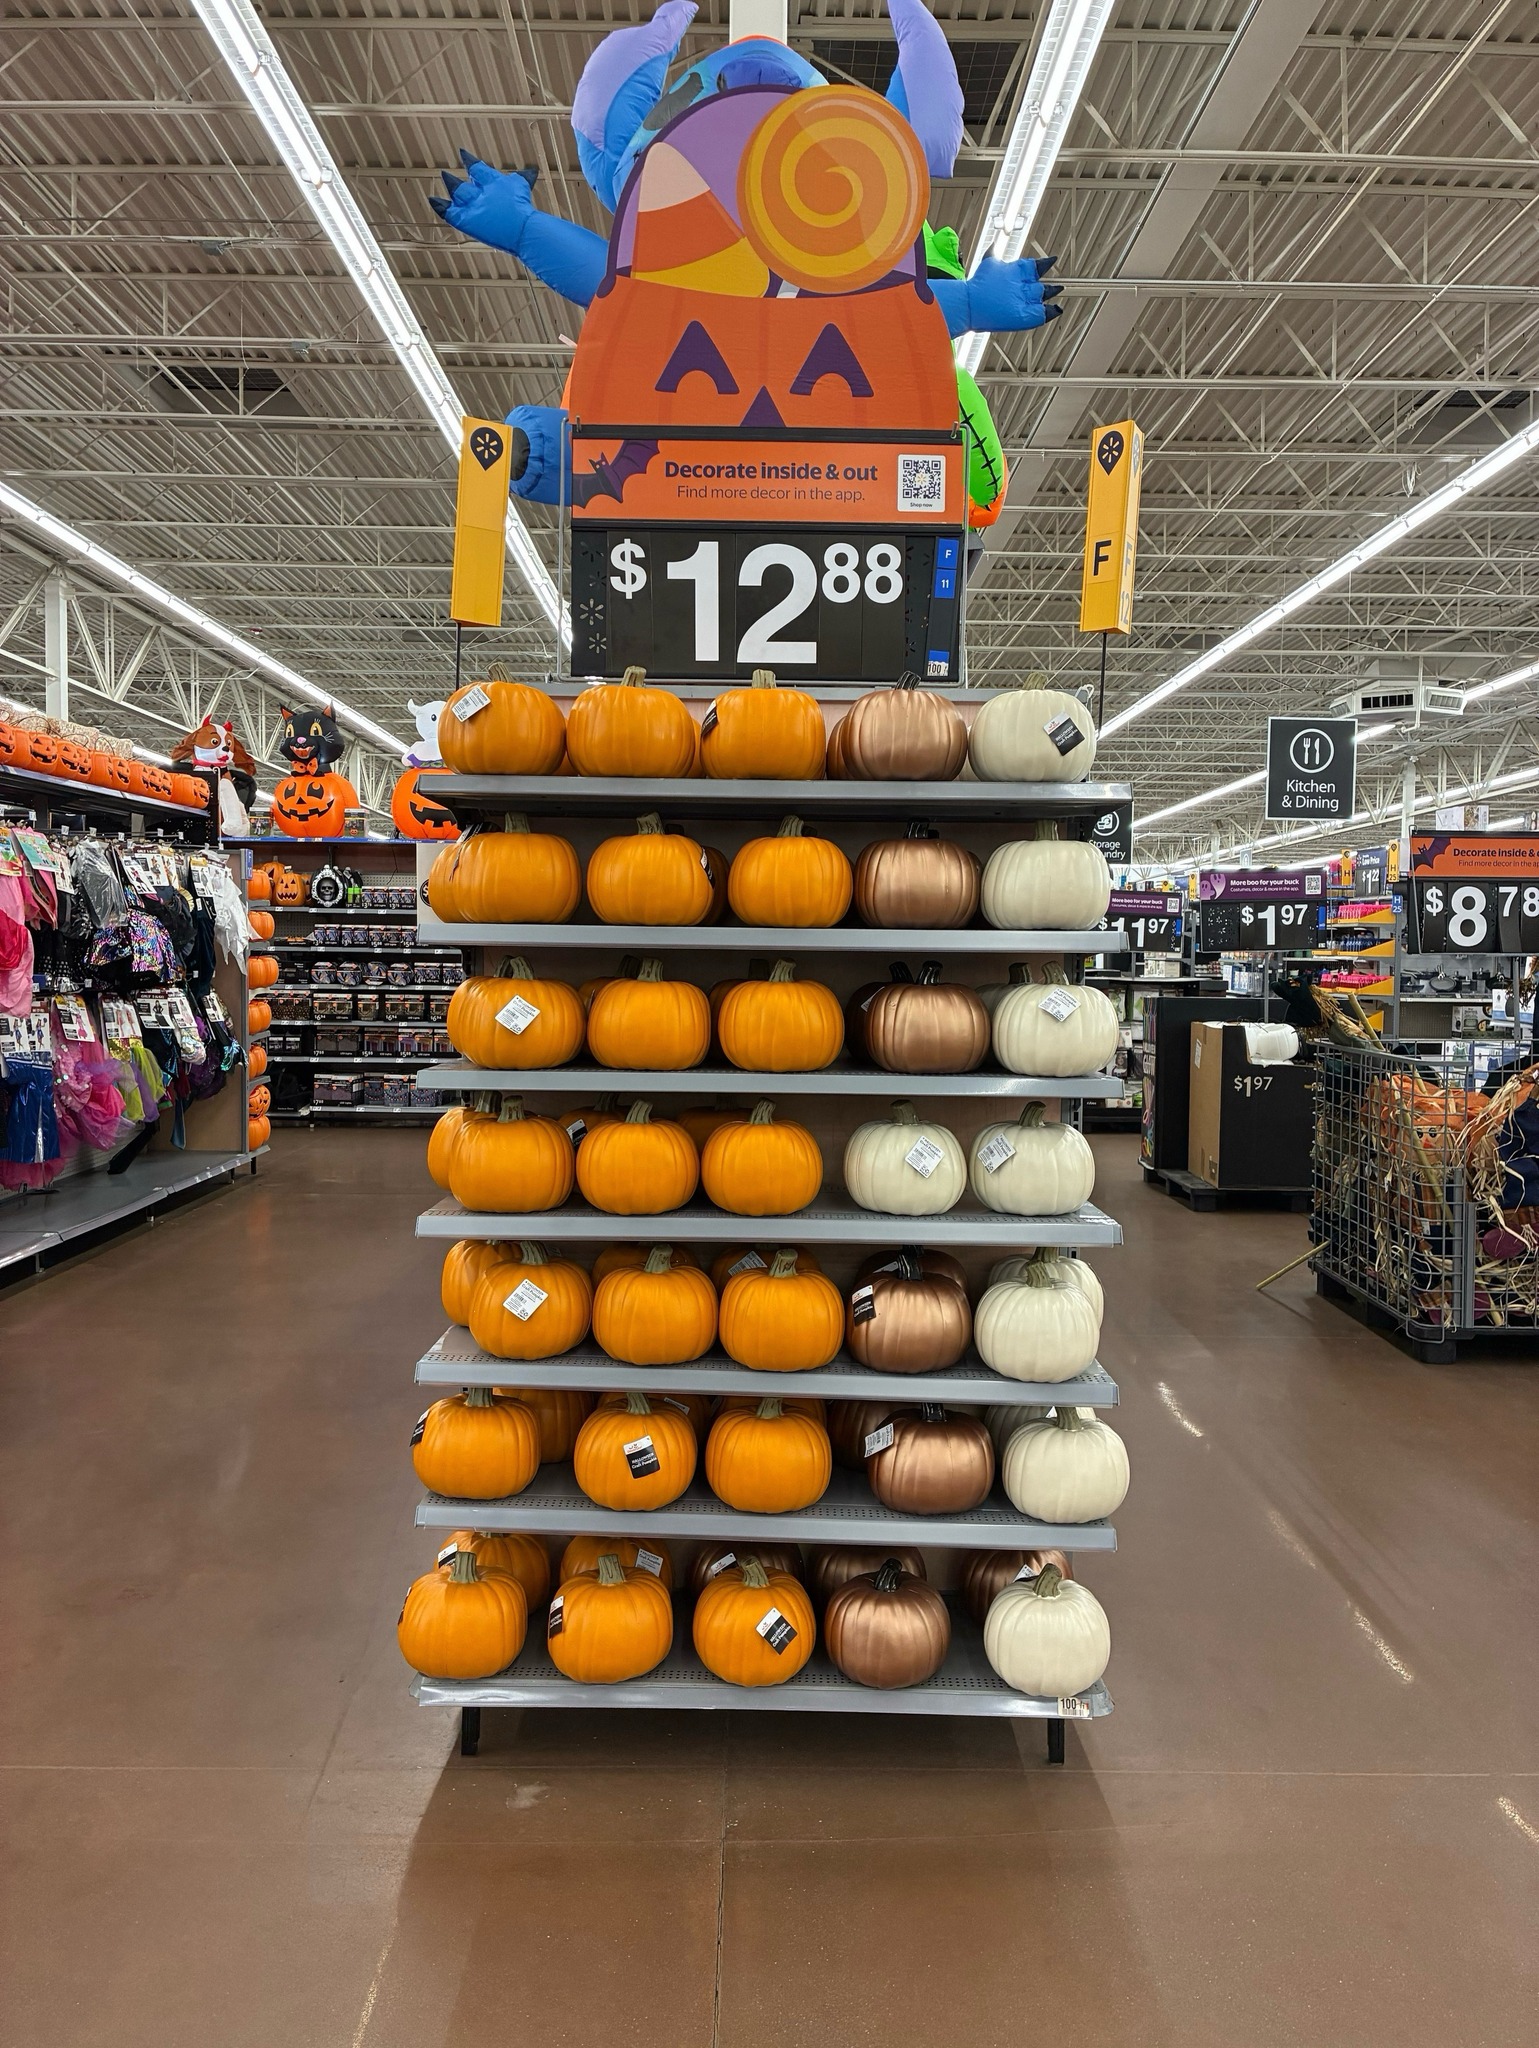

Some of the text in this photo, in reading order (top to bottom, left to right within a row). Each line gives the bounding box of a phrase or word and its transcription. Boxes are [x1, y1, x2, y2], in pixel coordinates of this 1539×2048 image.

[665, 461, 878, 481] Decorate inside & out
[677, 485, 866, 503] Find more decor in the app.
[945, 549, 952, 558] F
[1093, 539, 1112, 576] F
[1123, 541, 1133, 577] F
[941, 579, 949, 589] 11
[1120, 590, 1130, 626] 12
[1286, 779, 1336, 793] Kitchen
[1281, 794, 1339, 813] & Dining
[1453, 848, 1497, 857] Decorate
[1498, 848, 1527, 858] inside
[1528, 848, 1536, 858] &
[1390, 864, 1397, 872] H
[1394, 896, 1401, 904] H
[631, 1453, 654, 1464] HALLOWEEN
[641, 1456, 657, 1466] Pumpkin
[769, 1622, 786, 1643] HALLOWEEN
[778, 1625, 791, 1640] Pumpkin
[1060, 1698, 1077, 1710] 100
